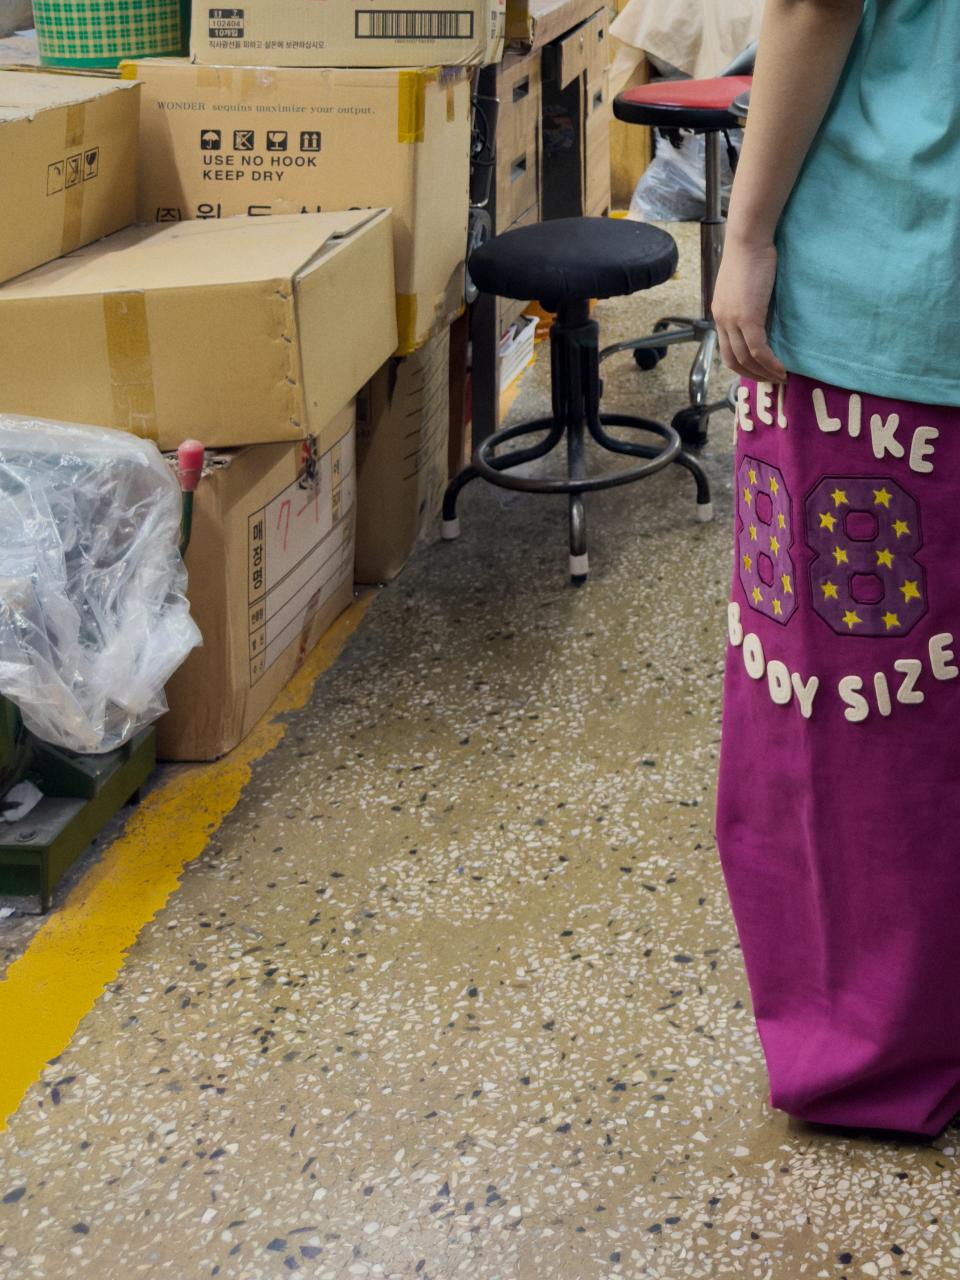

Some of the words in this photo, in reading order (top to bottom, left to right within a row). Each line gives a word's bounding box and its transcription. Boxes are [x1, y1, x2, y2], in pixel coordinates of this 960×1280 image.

[157, 101, 206, 111] WONDER
[212, 103, 252, 113] sequins
[256, 104, 307, 113] maximize
[309, 105, 334, 115] your
[337, 105, 376, 115] output.
[203, 155, 234, 166] USE
[241, 155, 264, 167] NO
[270, 156, 318, 168] HOOK
[203, 170, 245, 181] KEEP
[251, 171, 285, 182] DRY
[812, 387, 940, 473] LIKE
[838, 632, 960, 722] SIZE
